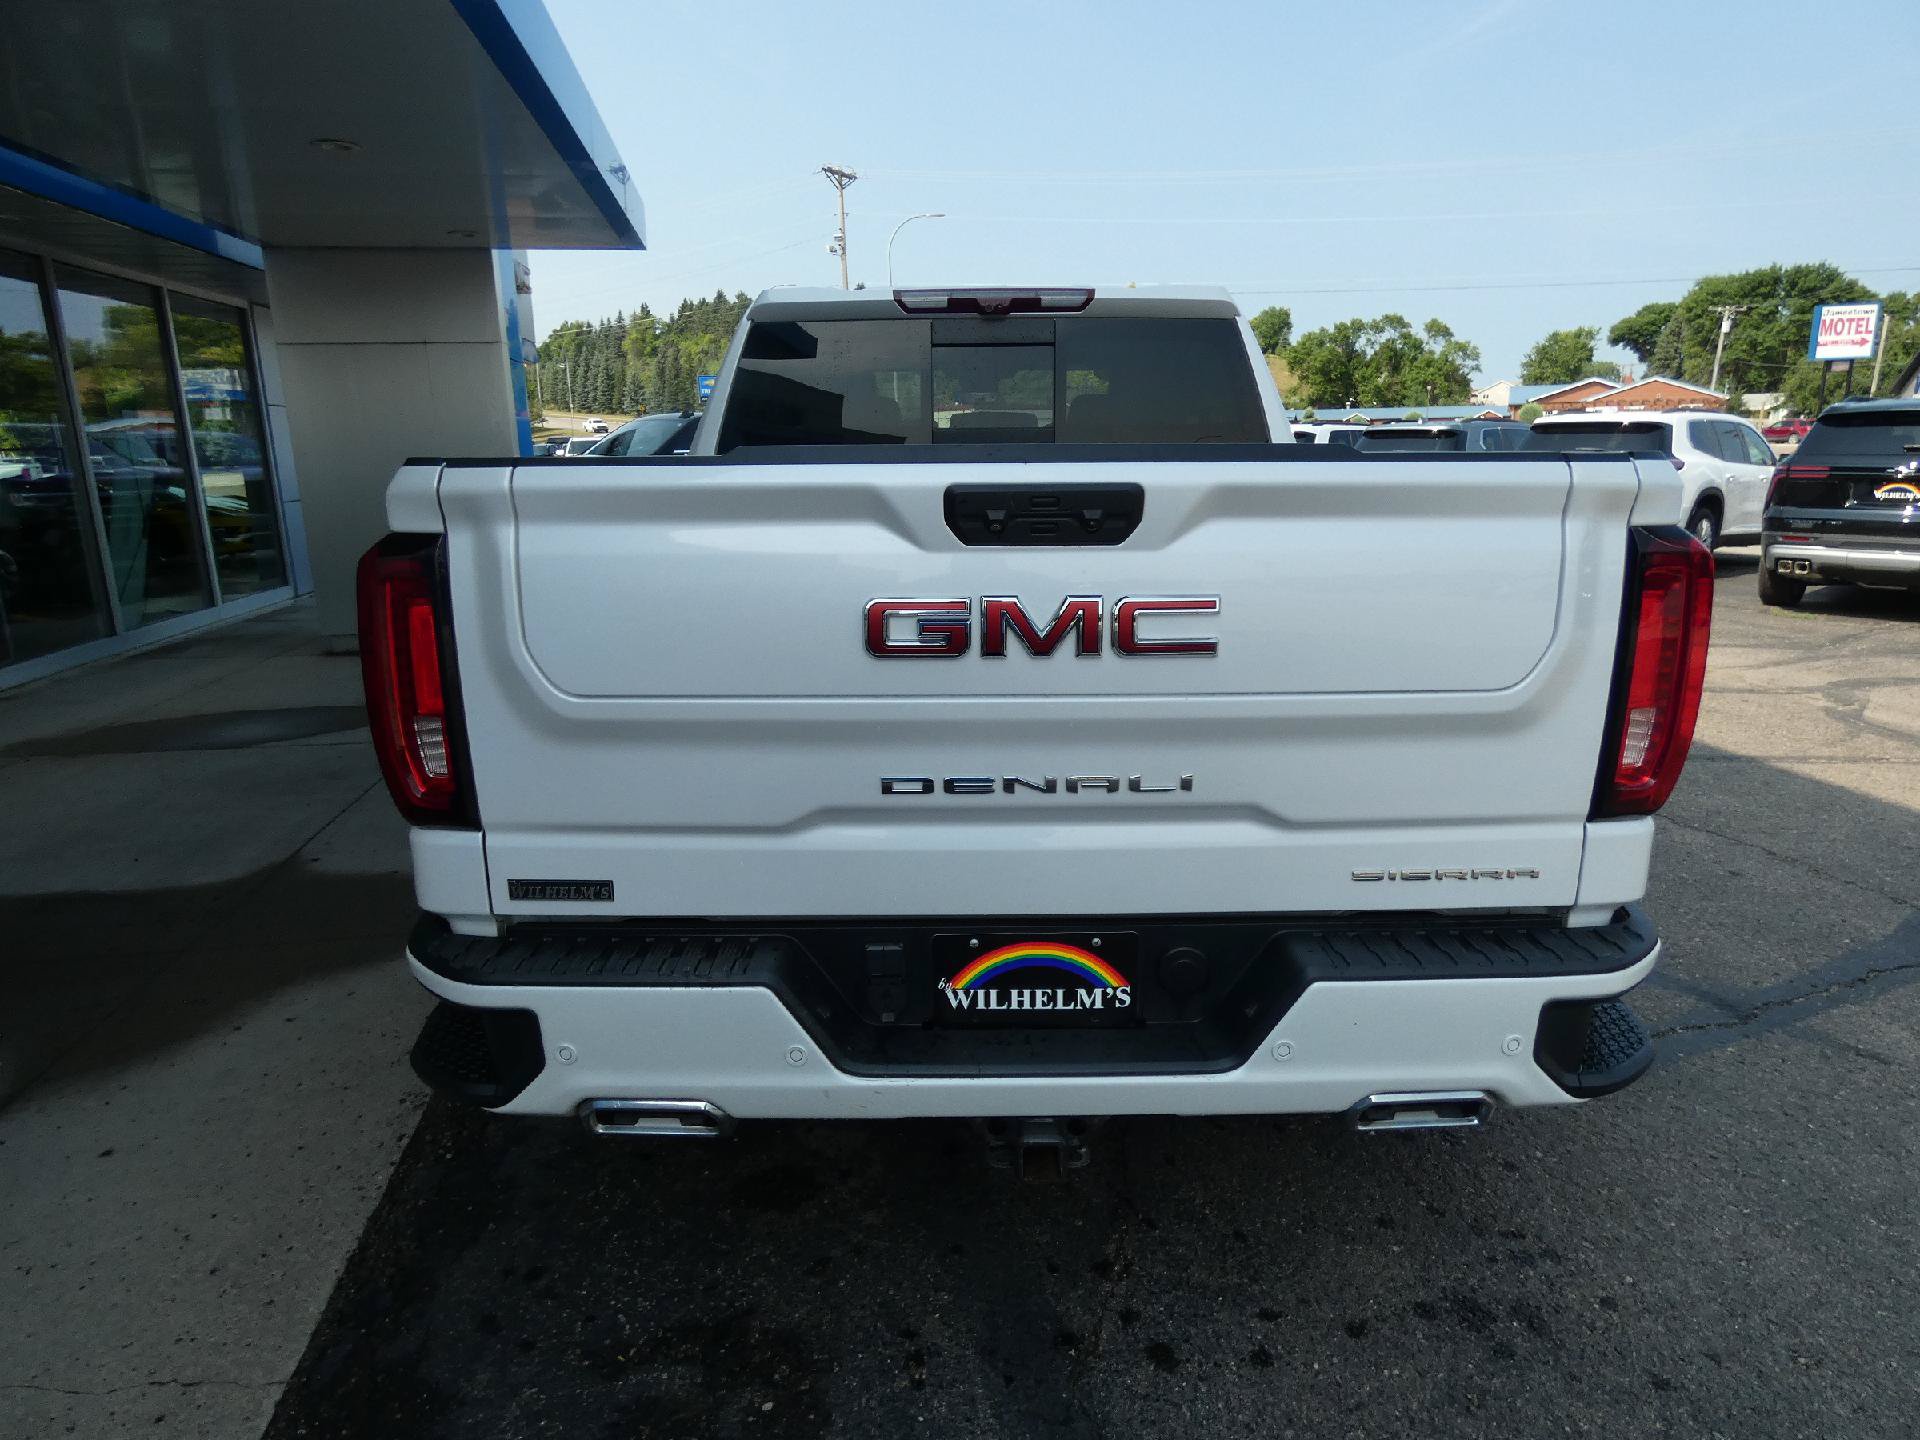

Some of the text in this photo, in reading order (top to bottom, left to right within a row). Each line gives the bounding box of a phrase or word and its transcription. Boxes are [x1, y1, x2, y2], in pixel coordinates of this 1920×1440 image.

[1820, 317, 1873, 336] MOTEL
[864, 595, 1221, 658] GMC
[880, 775, 1193, 794] DENALI
[1351, 869, 1540, 881] SIERRA
[511, 885, 610, 899] WILHELM'S
[945, 985, 1131, 1010] WILHELM'S
